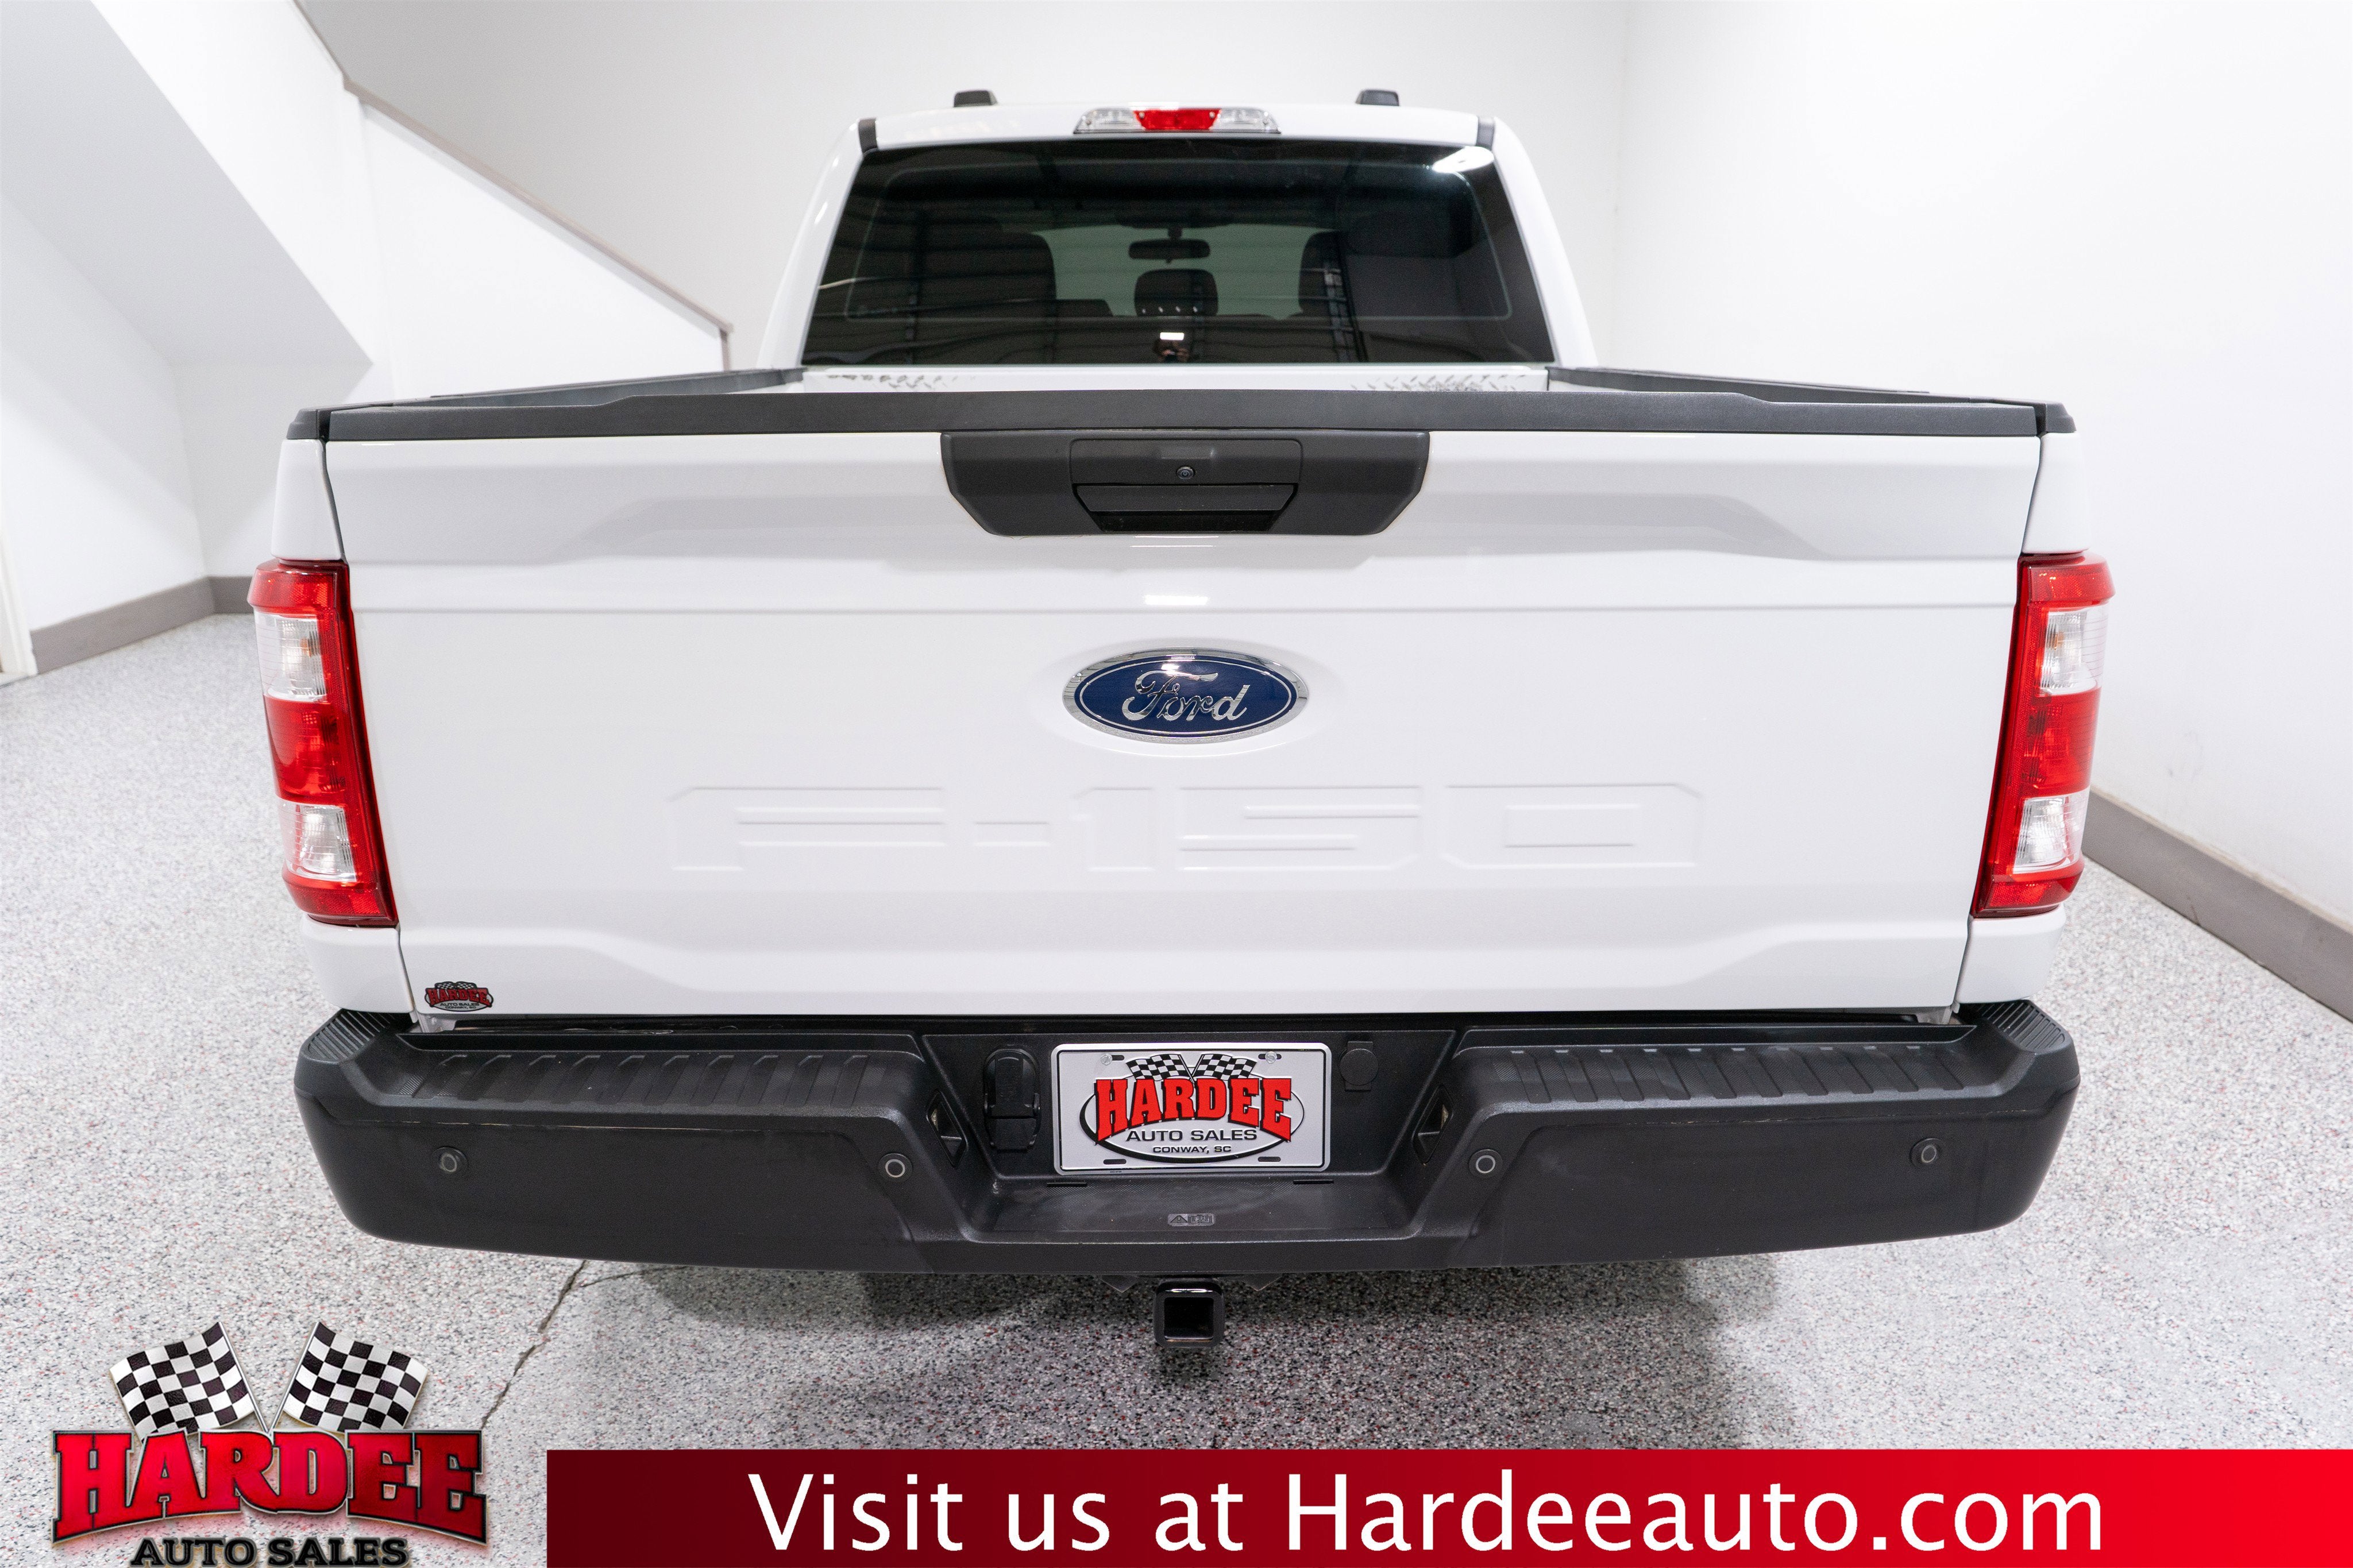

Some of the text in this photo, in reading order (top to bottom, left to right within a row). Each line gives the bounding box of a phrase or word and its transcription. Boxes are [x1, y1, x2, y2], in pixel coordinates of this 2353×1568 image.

[1122, 670, 1249, 721] Ford
[666, 784, 1704, 871] F-150
[427, 988, 492, 1006] HARDEE
[1094, 1078, 1292, 1143] HARDEE
[1126, 1129, 1257, 1142] AUTO SALES
[1152, 1146, 1209, 1154] CONWAY,
